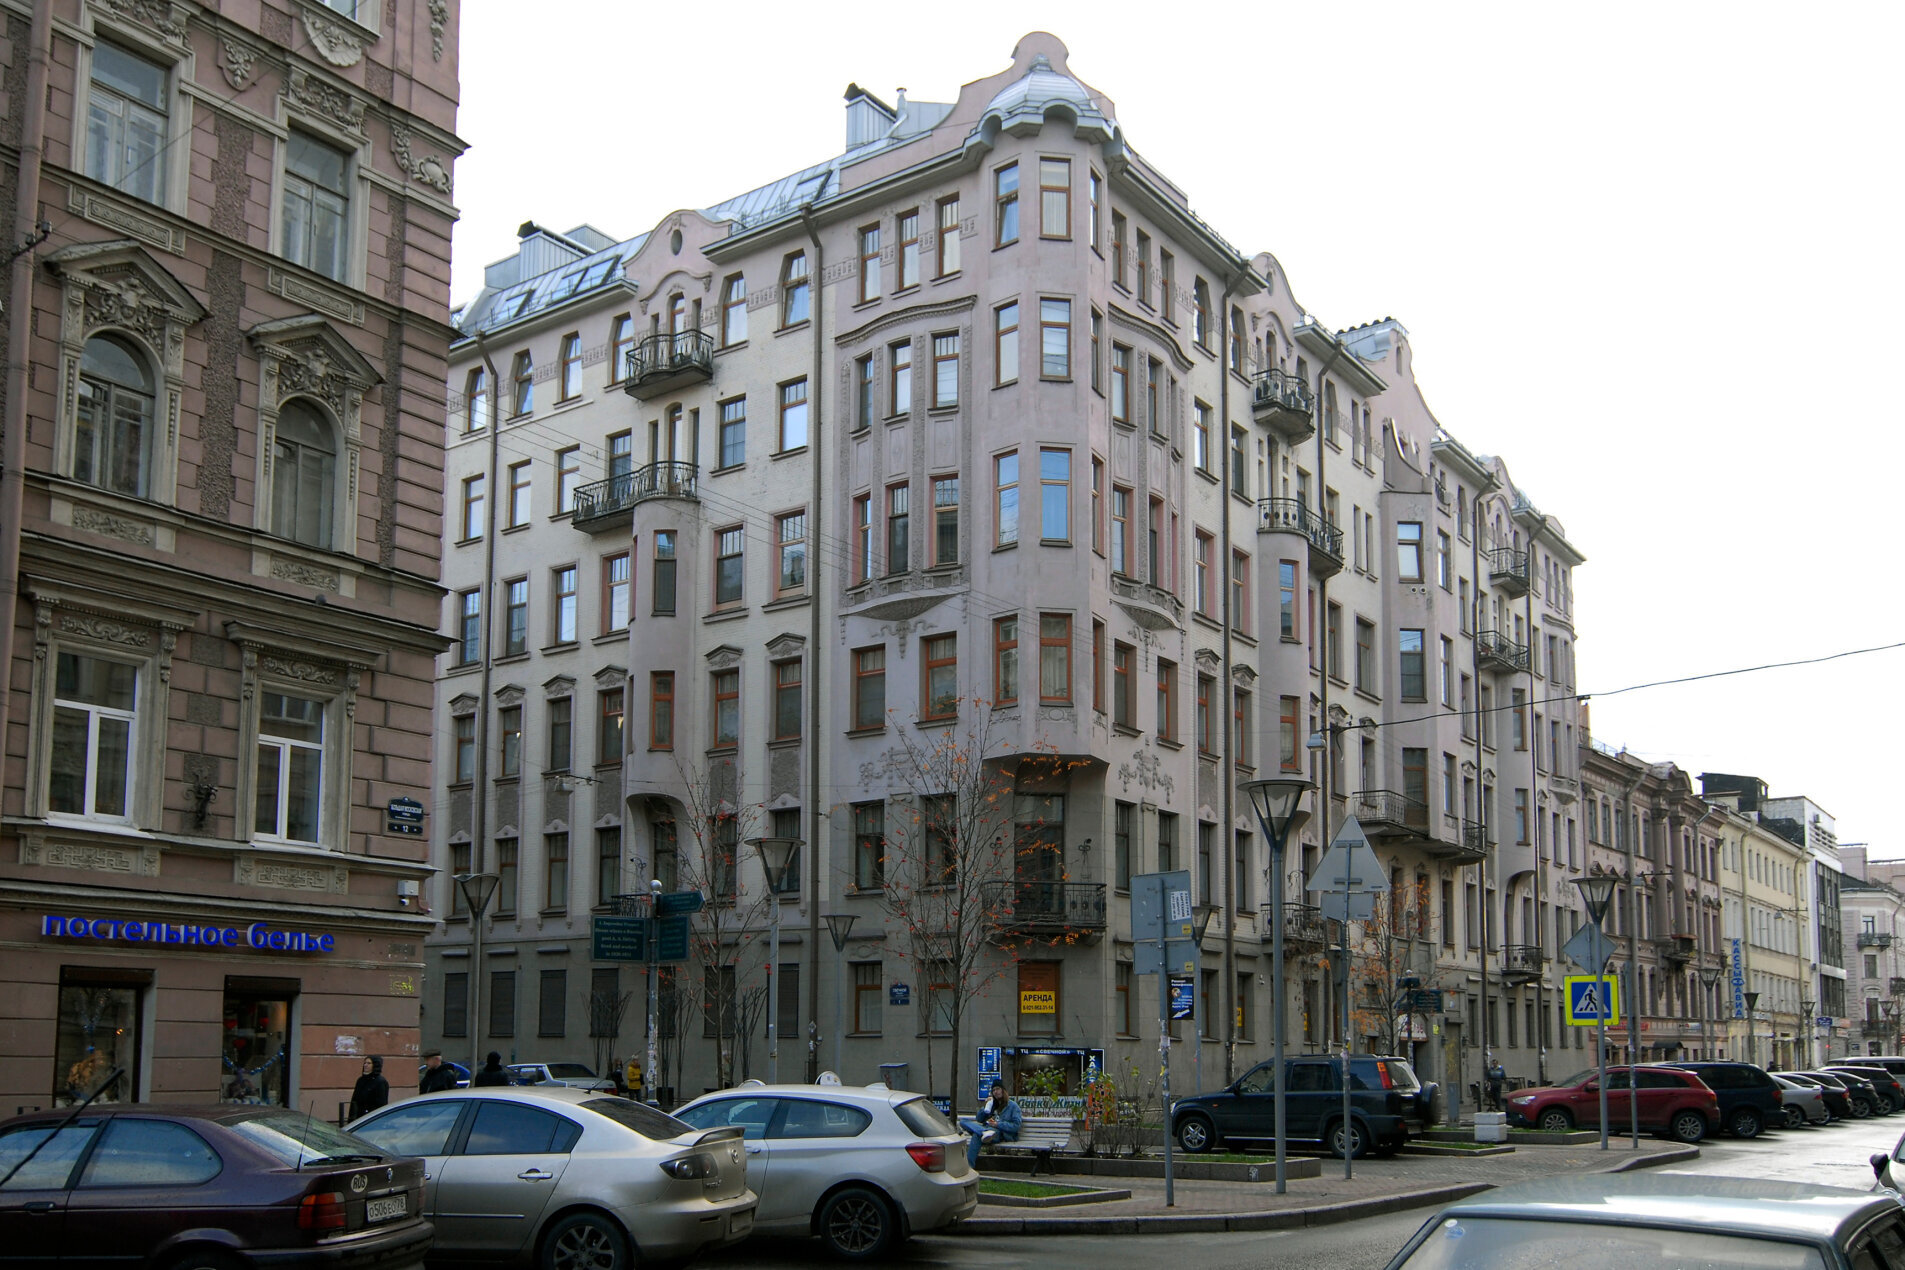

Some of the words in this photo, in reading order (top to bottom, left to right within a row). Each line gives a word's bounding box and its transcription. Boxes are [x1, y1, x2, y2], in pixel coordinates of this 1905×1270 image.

[402, 825, 409, 833] 12
[42, 915, 239, 947] постельное
[247, 922, 335, 952] белье
[1732, 939, 1742, 977] КАССЫ
[1024, 994, 1053, 1003] АРЕНДА
[1735, 986, 1743, 1018] АВИА
[353, 1174, 366, 1189] RUS
